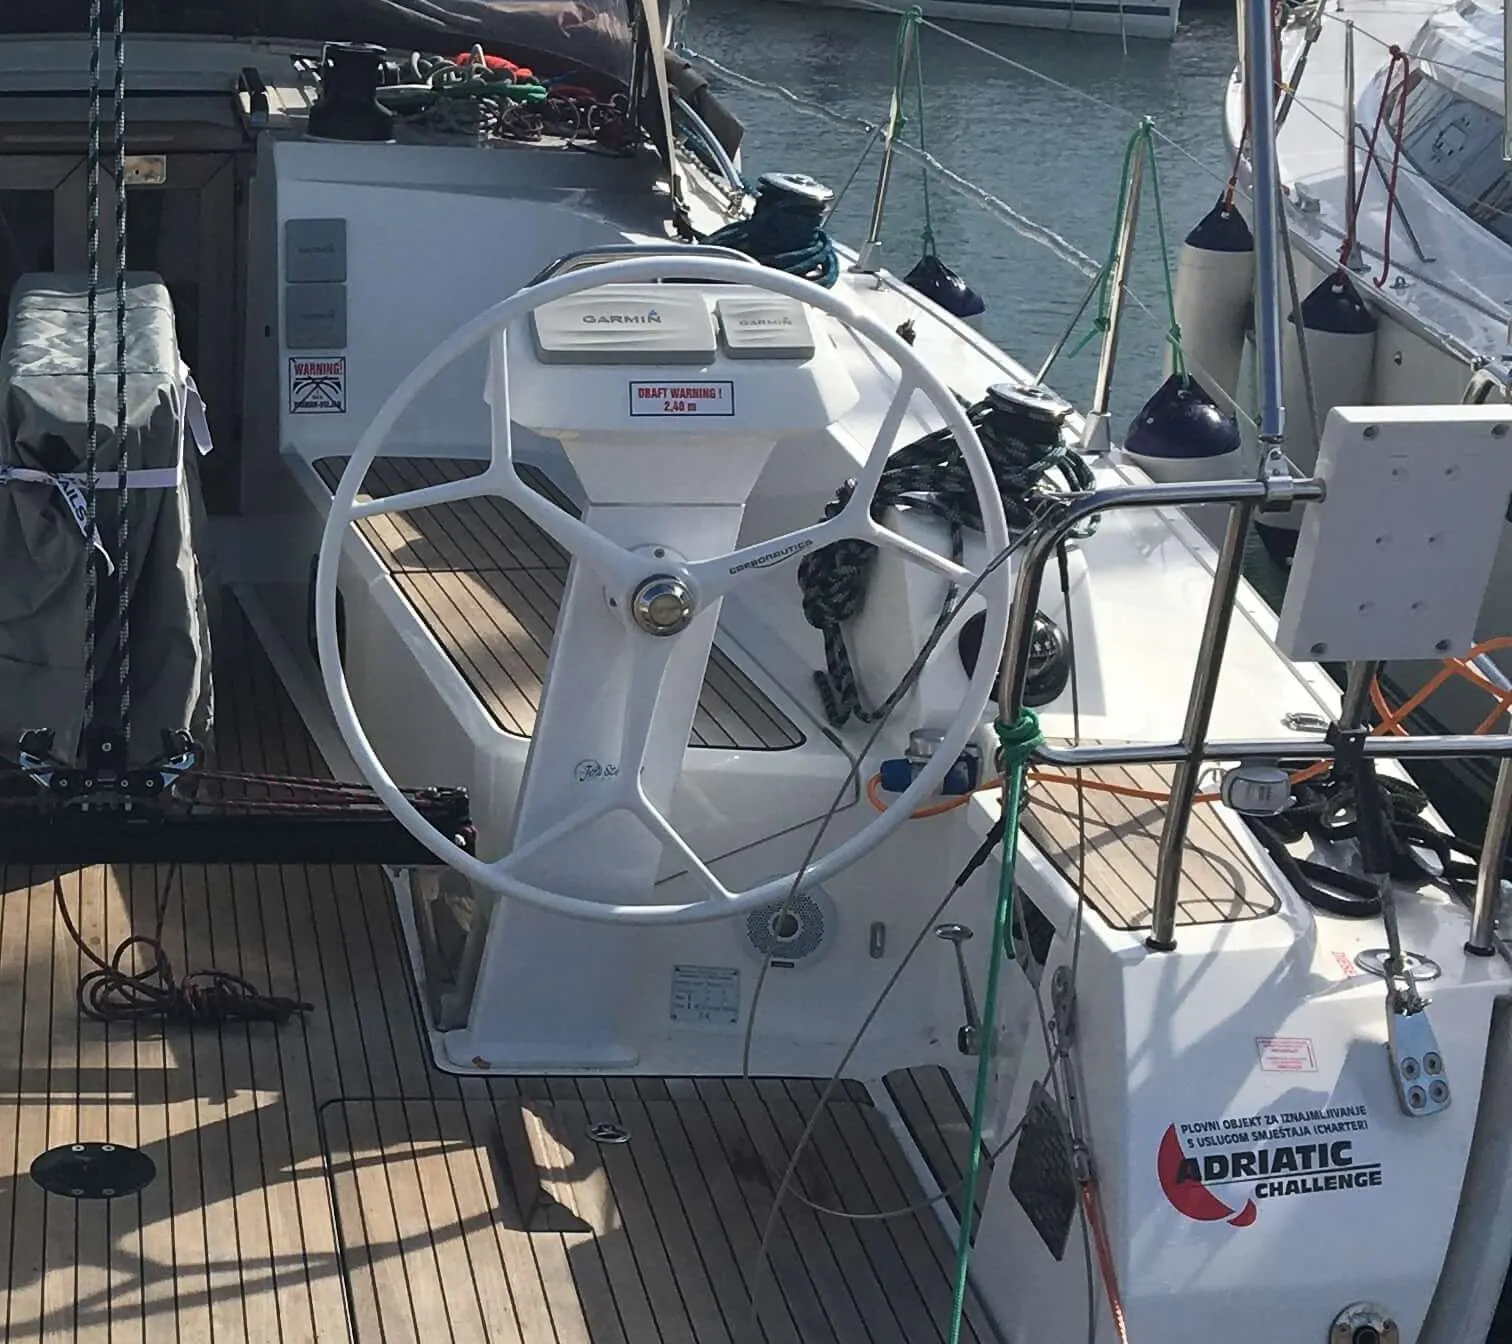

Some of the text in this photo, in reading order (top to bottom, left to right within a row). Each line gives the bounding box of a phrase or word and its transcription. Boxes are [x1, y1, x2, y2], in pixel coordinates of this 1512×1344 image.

[582, 309, 662, 324] GARMIN
[739, 317, 793, 326] GARMIN
[638, 387, 668, 399] DRAFT
[670, 387, 716, 399] WARNING
[57, 478, 88, 522] AILS
[1180, 1119, 1221, 1135] PLOVNI
[1222, 1115, 1263, 1131] OBJEKT
[1263, 1113, 1279, 1126] ZA
[1187, 1137, 1195, 1149] S
[1196, 1130, 1250, 1148] USLUGOM
[1176, 1140, 1354, 1185] ADRIATIC
[1254, 1170, 1383, 1199] CHALLENGE
